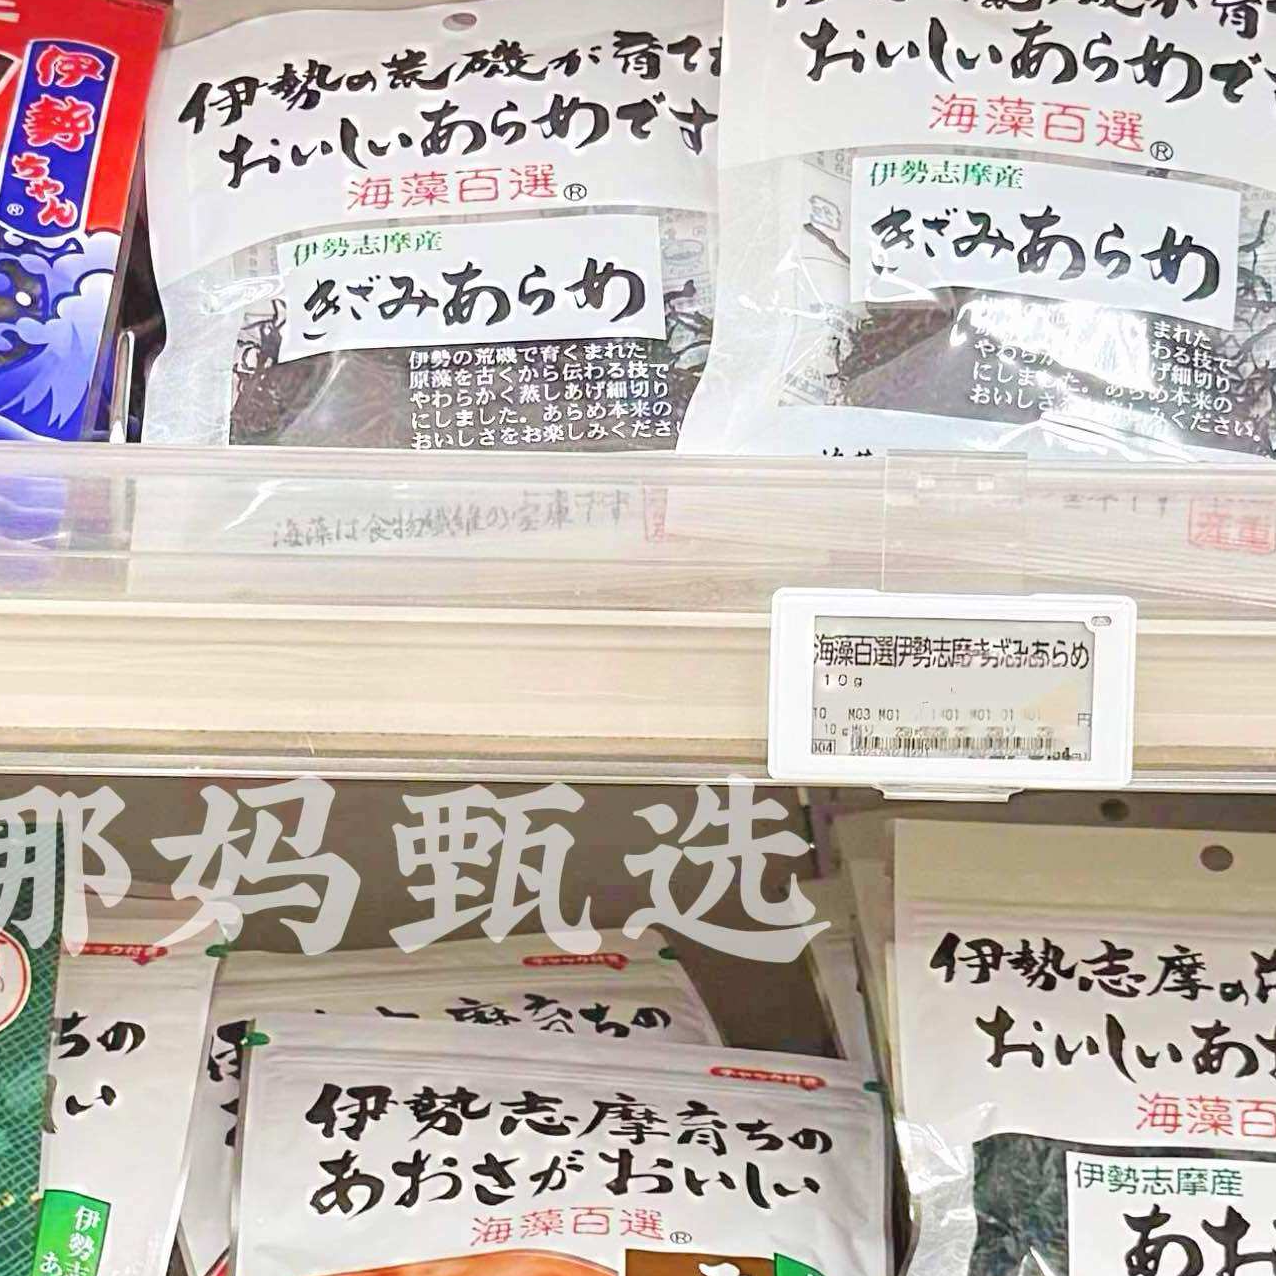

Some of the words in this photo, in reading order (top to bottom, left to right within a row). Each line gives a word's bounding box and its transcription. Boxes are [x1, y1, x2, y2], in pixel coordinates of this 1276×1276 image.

[12, 46, 105, 231] 伊勢ちゃん
[219, 94, 719, 190] おいしいあらめです
[928, 93, 1145, 153] 海藻百選
[346, 163, 558, 210] 海藻百選
[870, 160, 1025, 191] 伊勢志摩産
[292, 231, 443, 266] 伊勢志摩産
[870, 206, 1221, 302] きざみあらめ
[302, 257, 647, 341] きざみあらめ
[408, 343, 648, 369] 伊勢の荒磯で育くまれた
[409, 362, 671, 391] 原藻を古くから伝わる技で
[409, 381, 671, 409] やわらかく蒸しあげ細切り
[411, 401, 672, 428] にしました。あらめ本来の
[823, 674, 863, 688] 10g
[306, 1082, 833, 1156] 伊勢志摩育ちの
[311, 1147, 822, 1219] あおさがおいしい
[1075, 1161, 1245, 1198] 伊勢志摩産
[471, 1207, 664, 1248] 海藻百選
